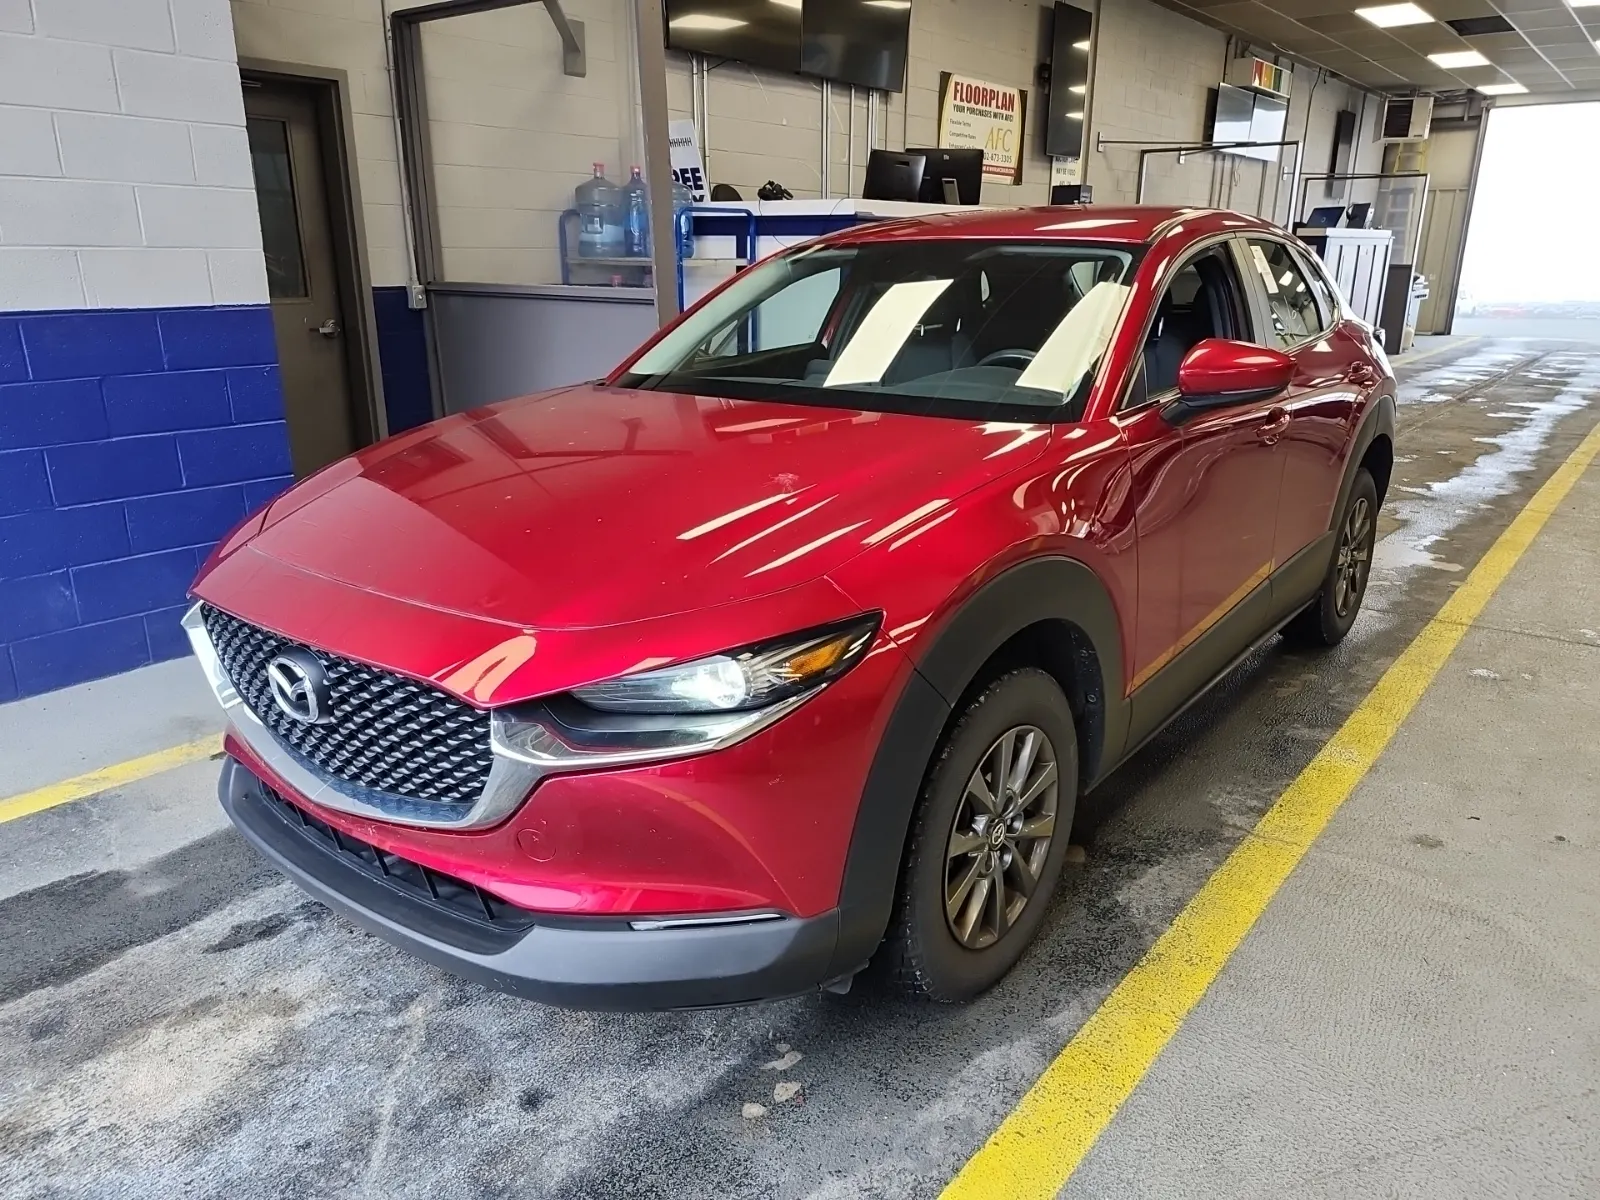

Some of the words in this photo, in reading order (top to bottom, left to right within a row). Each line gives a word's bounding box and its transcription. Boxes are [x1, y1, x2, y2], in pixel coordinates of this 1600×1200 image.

[953, 81, 1015, 112] FLOORPLAN
[953, 104, 965, 113] YOUR
[985, 127, 1012, 152] AFC
